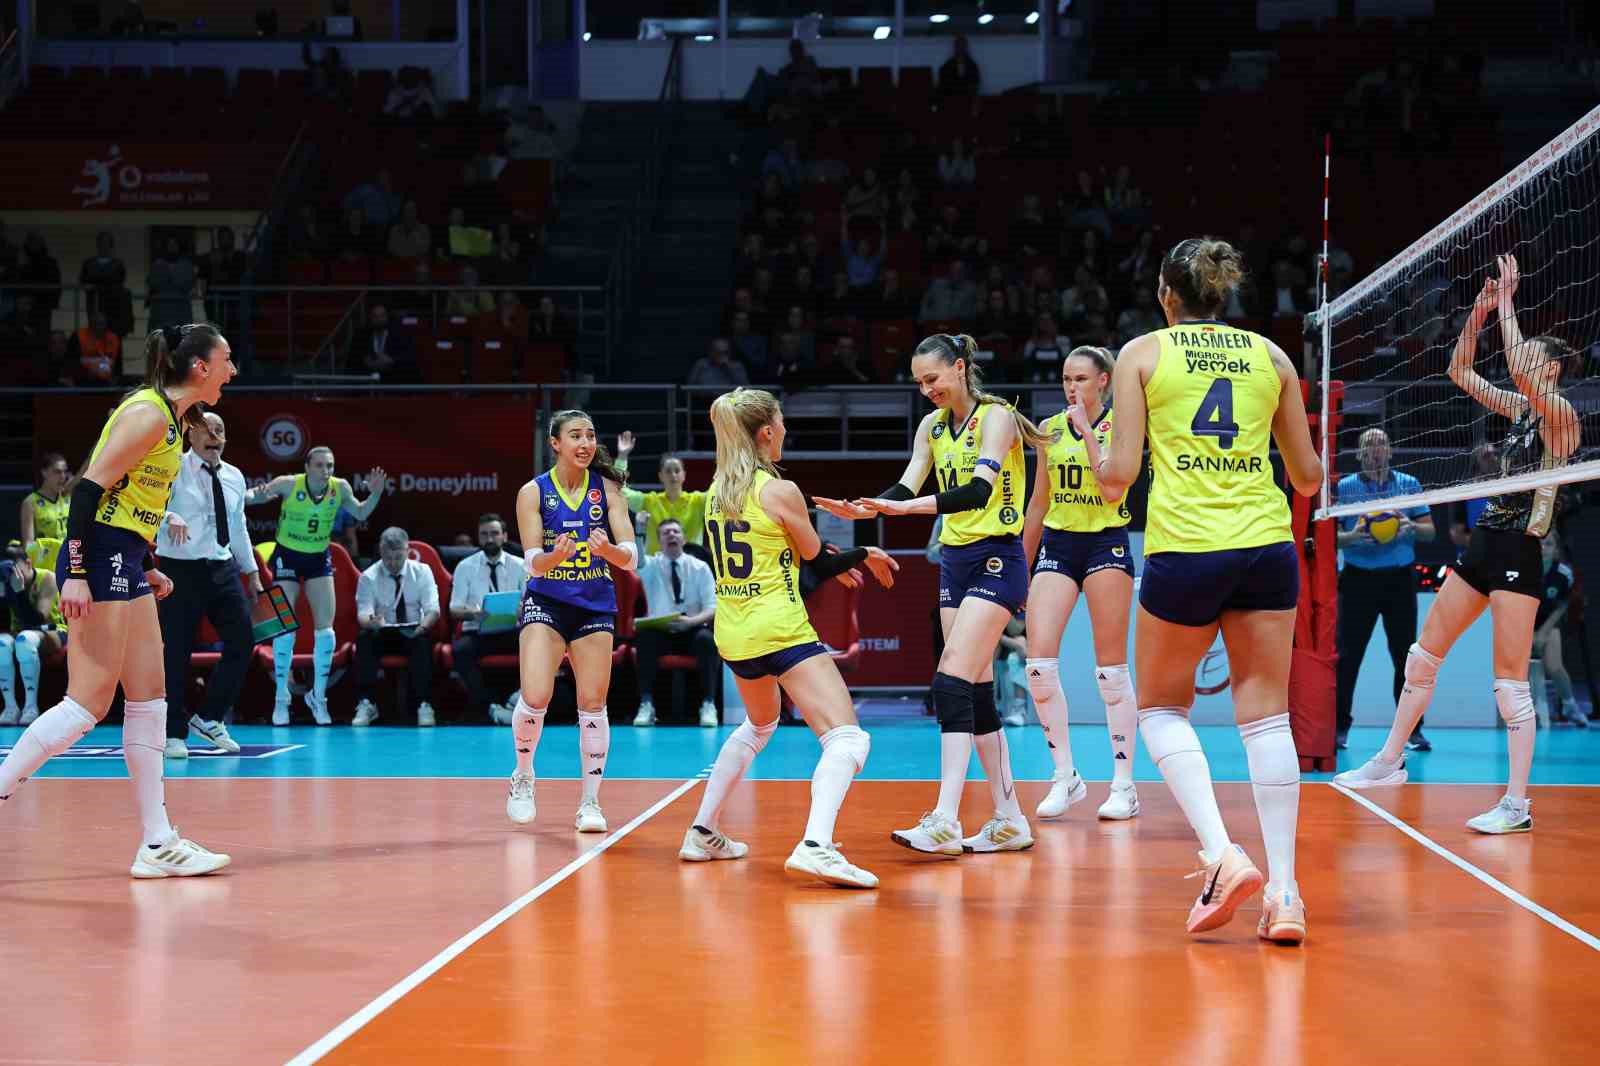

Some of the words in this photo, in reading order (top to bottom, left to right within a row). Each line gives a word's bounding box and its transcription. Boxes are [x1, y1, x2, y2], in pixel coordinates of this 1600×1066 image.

[1169, 331, 1252, 349] YAASMEEN
[1186, 358, 1251, 373] yemek
[1190, 377, 1240, 450] 4
[271, 431, 295, 446] 5G
[1176, 454, 1262, 472] SANMAR
[400, 472, 498, 496] Deneyimi
[939, 467, 958, 493] 14
[1057, 463, 1083, 490] 10
[308, 519, 319, 534] 9
[708, 519, 754, 579] 15
